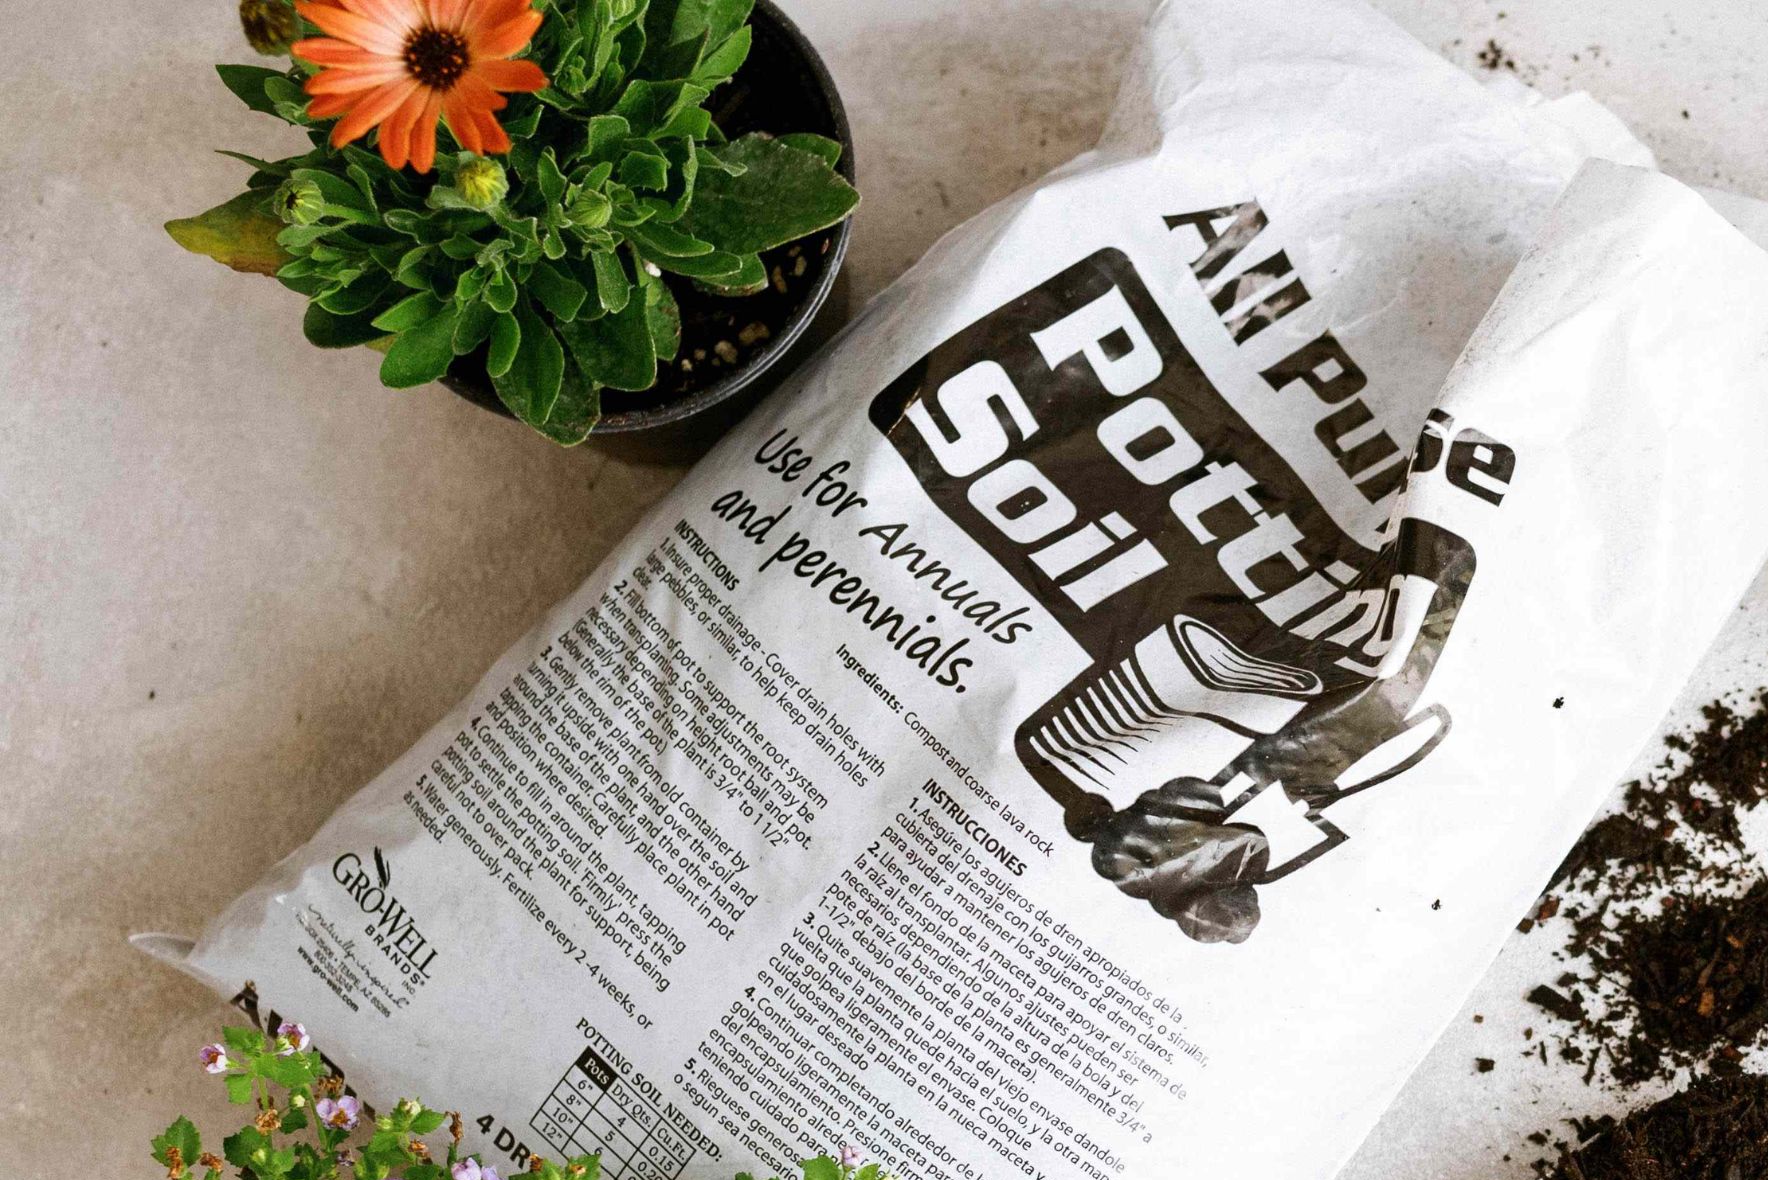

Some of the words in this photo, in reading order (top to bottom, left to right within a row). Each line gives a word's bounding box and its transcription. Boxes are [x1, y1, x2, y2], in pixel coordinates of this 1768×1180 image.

[1163, 198, 1312, 346] All
[673, 518, 740, 591] INSTRUCTIONS
[754, 428, 812, 482] Use
[802, 460, 867, 517] for
[858, 524, 1032, 644] Annuals
[905, 359, 1168, 612] Soil
[1030, 284, 1441, 681] Potting
[658, 571, 699, 616] pebbles,
[696, 610, 711, 625] or
[706, 622, 741, 662] similar,
[738, 654, 754, 672] to
[750, 665, 779, 697] help
[775, 691, 807, 726] keep
[804, 723, 836, 756] drain
[833, 749, 869, 787] holes
[710, 490, 792, 544] and
[758, 531, 972, 693] perennials.
[495, 717, 537, 762] position
[534, 757, 568, 796] where
[564, 793, 608, 840] desired.
[622, 617, 680, 686] transplanting.
[677, 680, 709, 716] Some
[705, 711, 774, 782] adjustments
[770, 778, 800, 807] may
[796, 800, 815, 824] be
[836, 644, 903, 713] Ingredients:
[903, 711, 950, 761] Compost
[945, 756, 970, 779] and
[964, 775, 1000, 811] coarse
[998, 803, 1025, 833] lava
[1023, 829, 1054, 858] rock
[470, 778, 494, 802] soil
[486, 797, 528, 840] around
[522, 835, 542, 860] the
[537, 856, 571, 891] plant
[568, 884, 588, 907] for
[584, 904, 633, 958] support,
[632, 949, 671, 993] being
[528, 720, 547, 744] the
[544, 741, 594, 797] container.
[592, 792, 640, 845] Carefully
[633, 840, 668, 876] place
[663, 871, 700, 907] plant
[696, 900, 711, 920] in
[706, 915, 735, 942] pot
[921, 777, 1028, 877] INSTRUCCIONES
[780, 942, 805, 967] que
[801, 963, 845, 1004] golpea
[843, 996, 918, 1064] ligeramente
[917, 1061, 935, 1075] el
[930, 1072, 976, 1112] envase.
[978, 1106, 1032, 1151] Coloque
[802, 911, 815, 930] 3.
[816, 924, 850, 959] Quite
[847, 955, 922, 1021] suavemente
[920, 1014, 935, 1032] la
[931, 1027, 976, 1063] planta
[975, 1059, 1001, 1080] del
[998, 1075, 1029, 1103] viejo
[1029, 1100, 1074, 1136] envase
[853, 852, 867, 870] la
[864, 866, 888, 890] raíz
[884, 885, 901, 900] al
[896, 895, 972, 963] transplantar.
[970, 957, 1026, 1004] Algunos
[1023, 999, 1069, 1037] ajustes
[1065, 1033, 1117, 1072] pueden
[1116, 1068, 1139, 1086] ser
[879, 826, 908, 853] para
[905, 848, 947, 887] ayudar
[943, 884, 954, 896] a
[952, 892, 1017, 944] mantener
[1013, 937, 1035, 960] los
[1033, 956, 1090, 1000] agujeros
[1088, 996, 1107, 1014] de
[1106, 1010, 1137, 1037] dren
[1136, 1033, 1174, 1065] claros.
[476, 1114, 494, 1134] 4
[575, 1016, 633, 1075] POTTING
[630, 1072, 663, 1108] SOIL
[662, 1101, 722, 1162] NEEDED:
[584, 1058, 609, 1084] Pots
[612, 1084, 633, 1106] Dry
[631, 1104, 650, 1127] Qts.
[657, 1128, 684, 1160] Cu.Ft.
[604, 1130, 615, 1141] 5
[617, 1117, 626, 1127] 4
[649, 1146, 674, 1171] 0.15
[729, 1000, 795, 1060] golpeando
[793, 1053, 868, 1121] ligeramente
[866, 1113, 880, 1131] la
[879, 1127, 927, 1167] maceta
